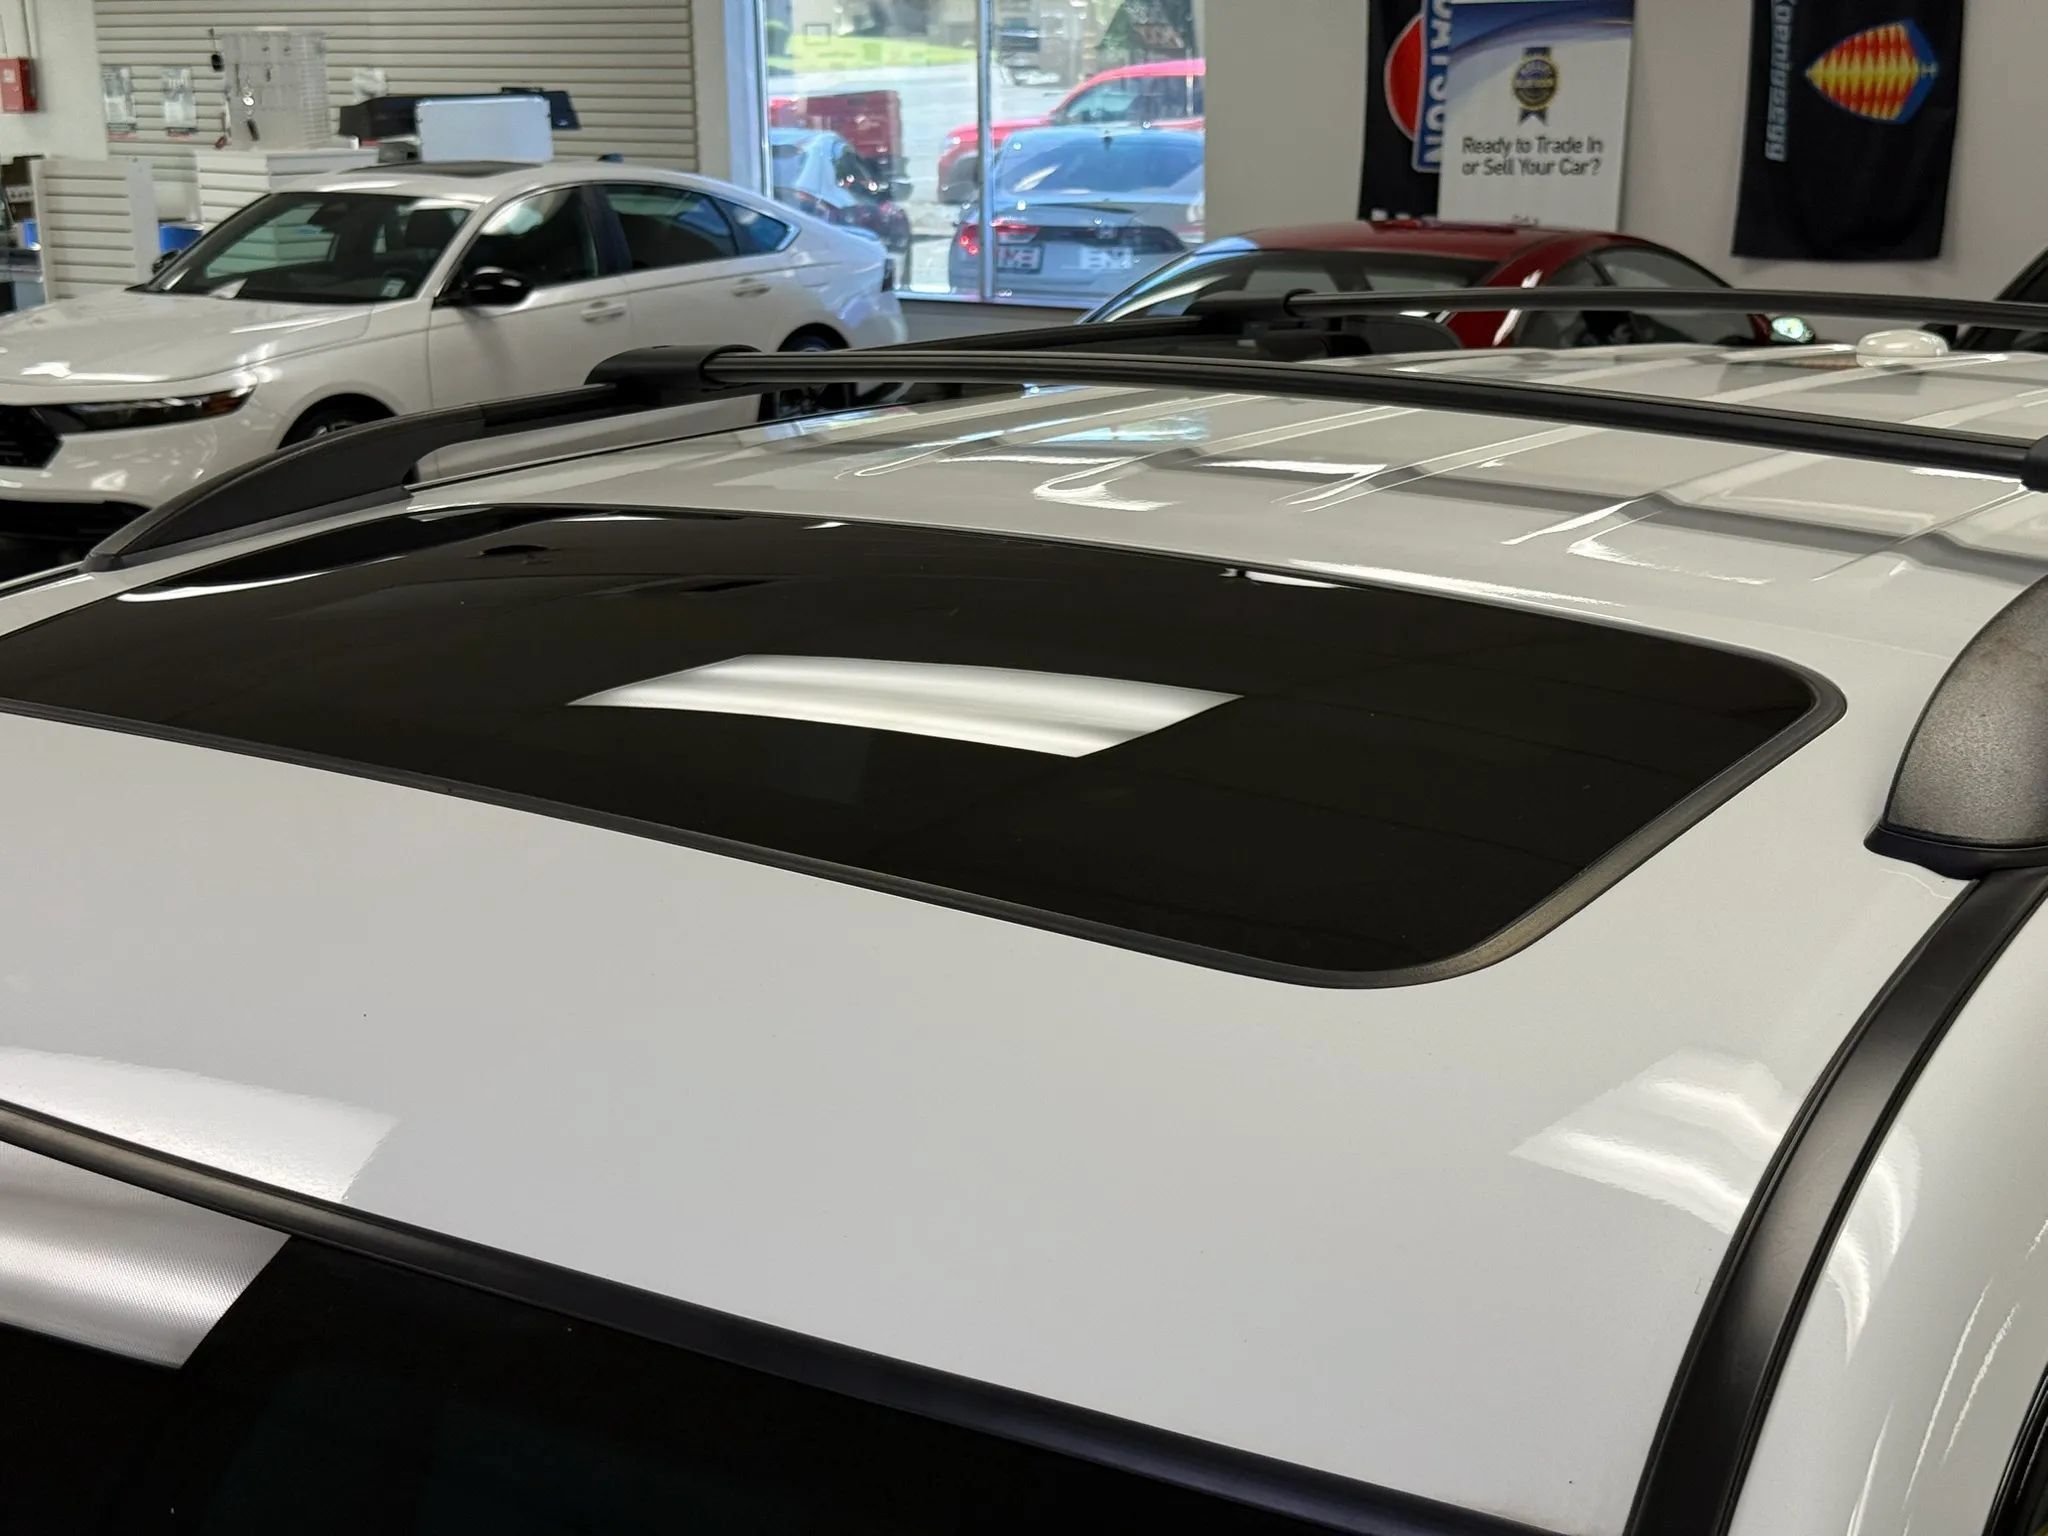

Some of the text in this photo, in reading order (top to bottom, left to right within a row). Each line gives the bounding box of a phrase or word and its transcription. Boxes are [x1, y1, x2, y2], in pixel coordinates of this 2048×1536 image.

[1462, 136, 1603, 159] Ready to Trade In
[1462, 158, 1601, 175] or Sell Your Car?
